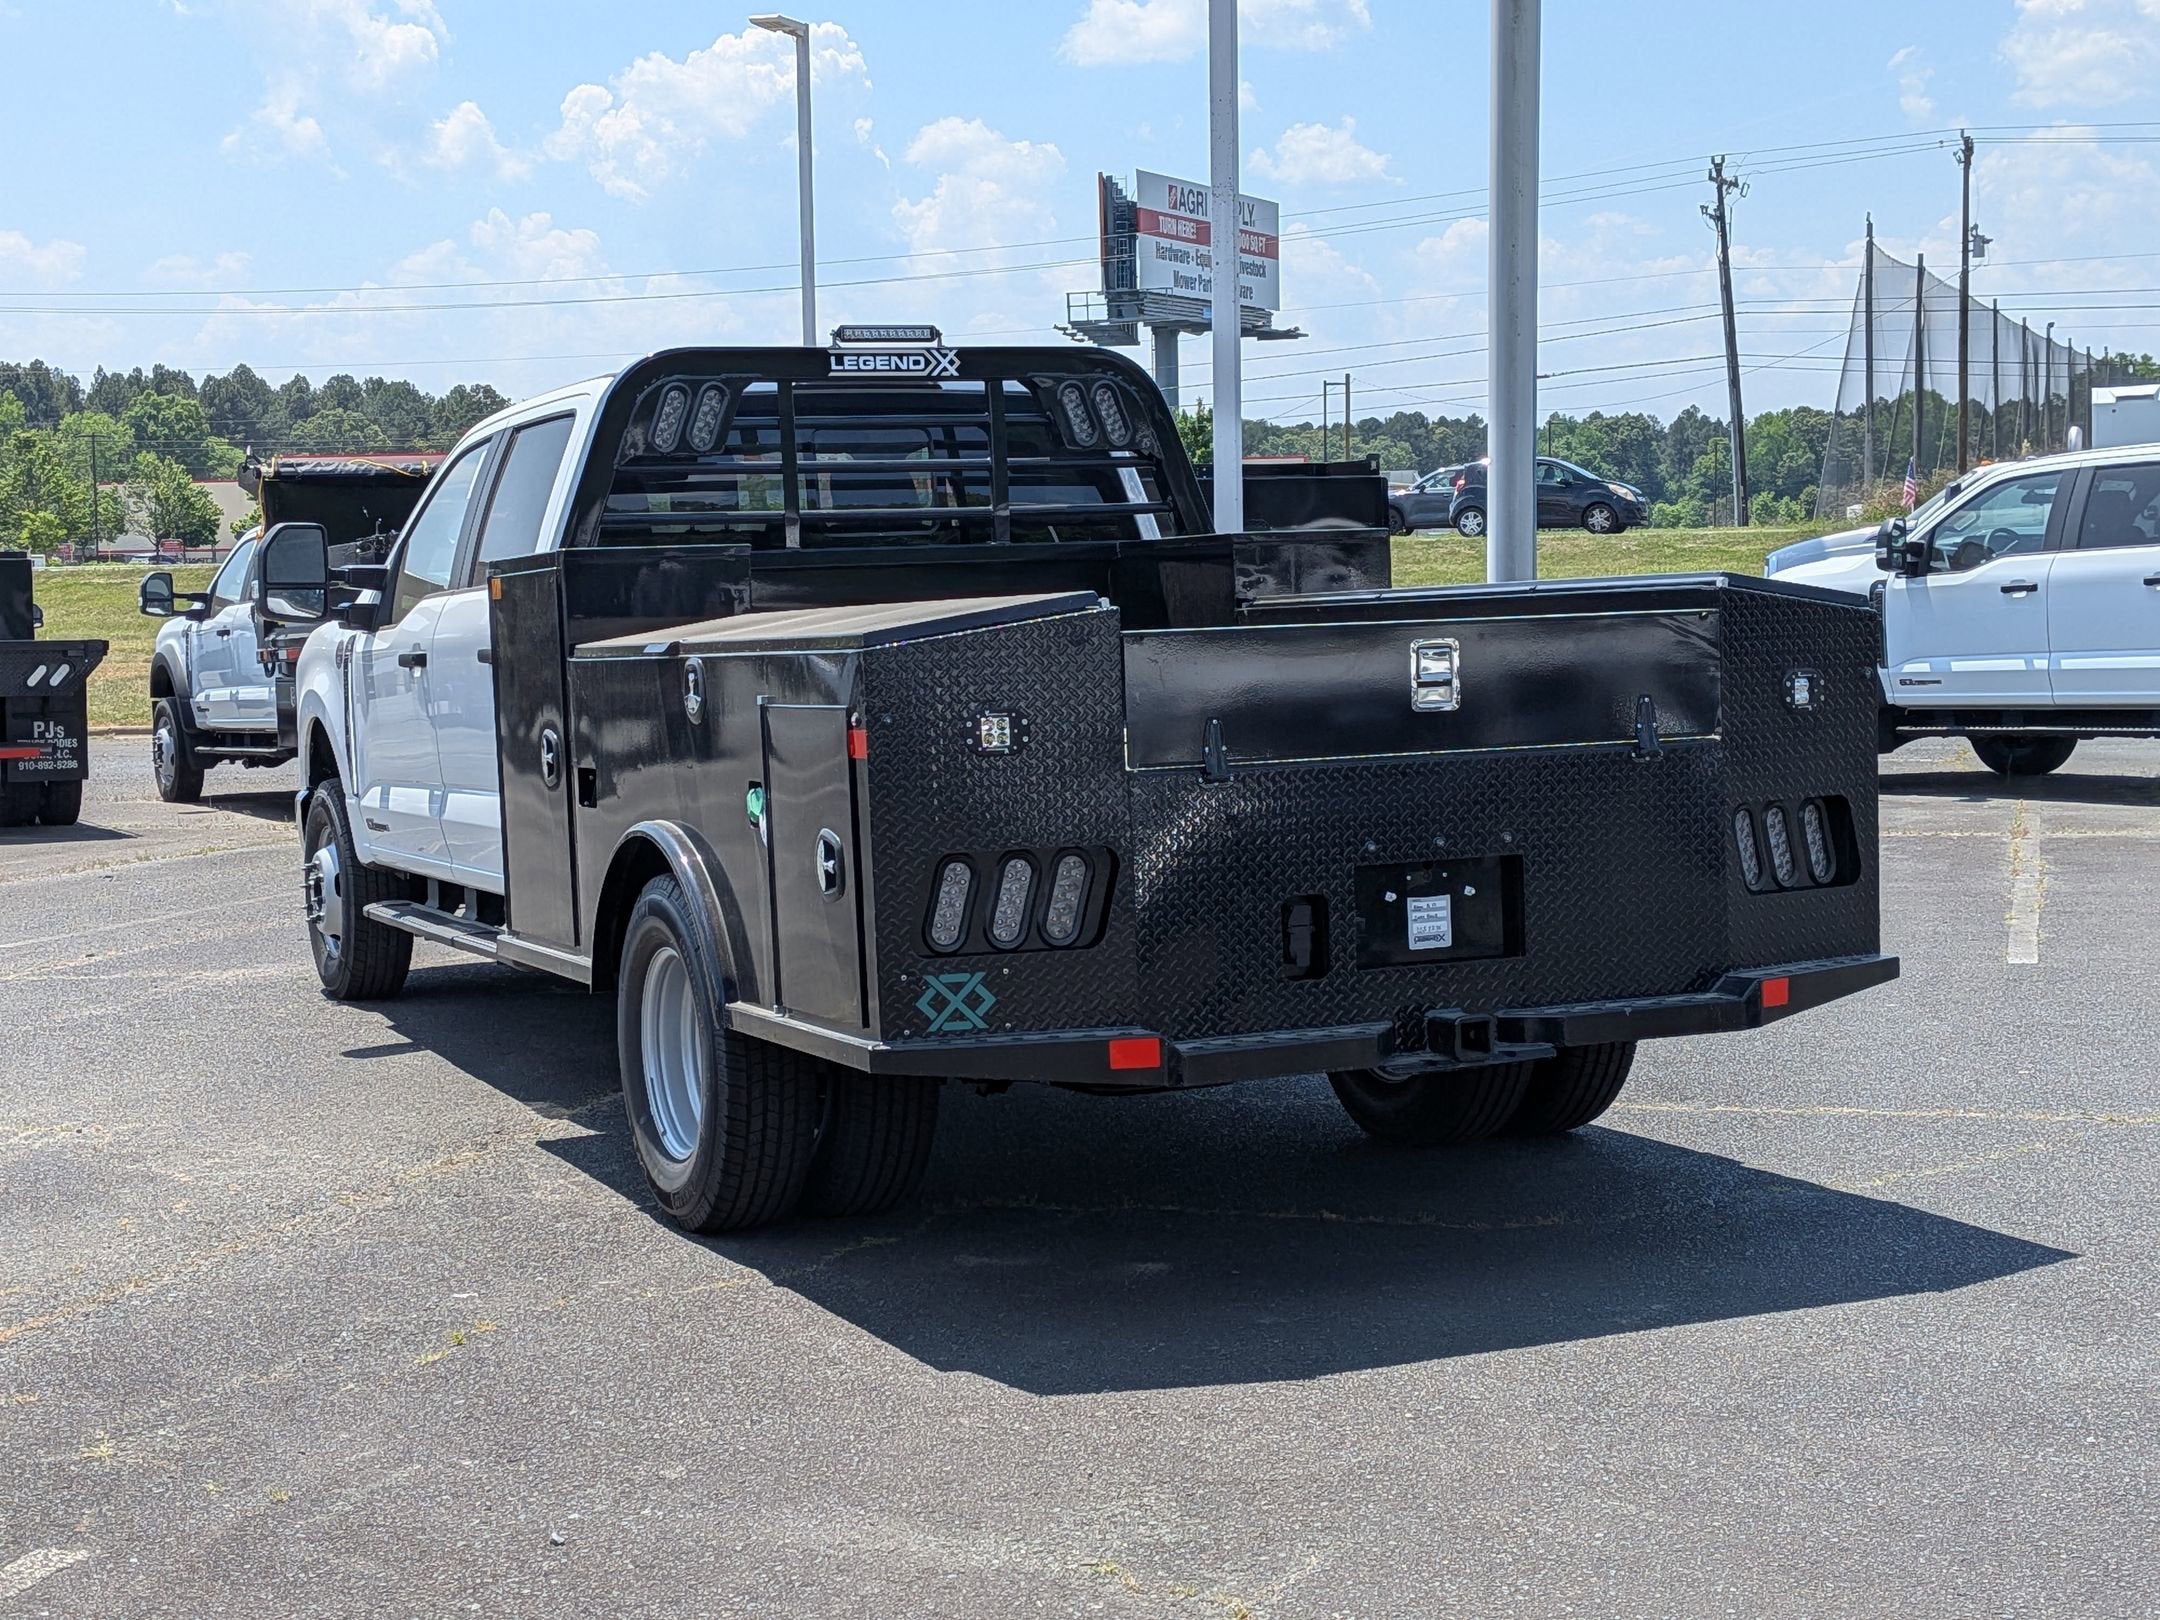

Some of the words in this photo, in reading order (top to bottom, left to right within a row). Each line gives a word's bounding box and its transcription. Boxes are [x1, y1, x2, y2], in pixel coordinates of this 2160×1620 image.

[1178, 186, 1208, 217] AGRI
[1158, 215, 1177, 236] TURN
[1155, 240, 1191, 265] Hardware
[1239, 255, 1267, 278] ivestock
[1173, 269, 1197, 291] Mower
